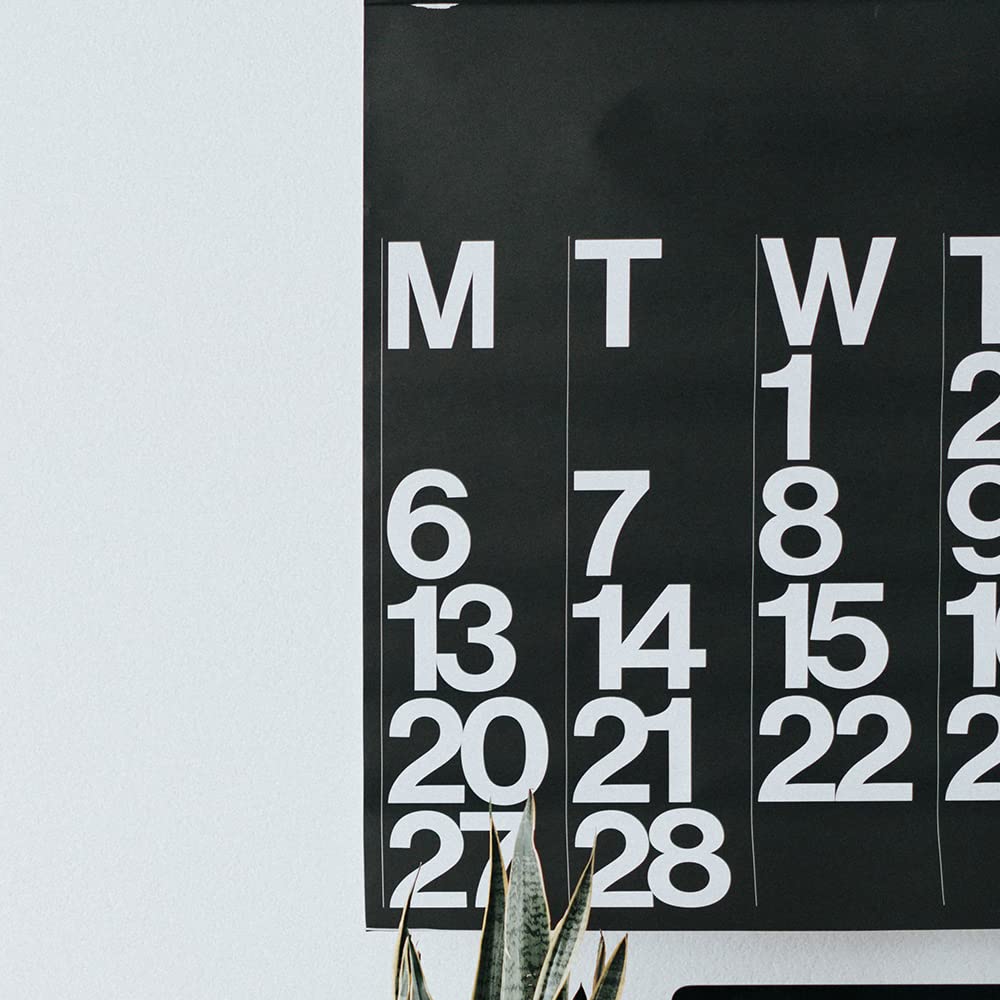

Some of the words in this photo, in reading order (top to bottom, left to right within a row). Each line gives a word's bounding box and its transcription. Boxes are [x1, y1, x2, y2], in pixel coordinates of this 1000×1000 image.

[388, 241, 495, 349] M
[575, 239, 662, 347] T
[761, 237, 897, 346] W
[950, 237, 1000, 344] T
[761, 355, 812, 460] 1
[948, 351, 1000, 460] 2
[387, 469, 471, 579] 6
[574, 470, 650, 576] 7
[759, 466, 843, 576] 8
[947, 464, 1000, 575] 9
[387, 584, 517, 692] 13
[572, 584, 706, 690] 14
[759, 583, 889, 689] 15
[946, 582, 1000, 687] 1
[388, 697, 549, 805] 20
[573, 697, 692, 803] 21
[758, 695, 913, 802] 22
[574, 808, 732, 908] 28
